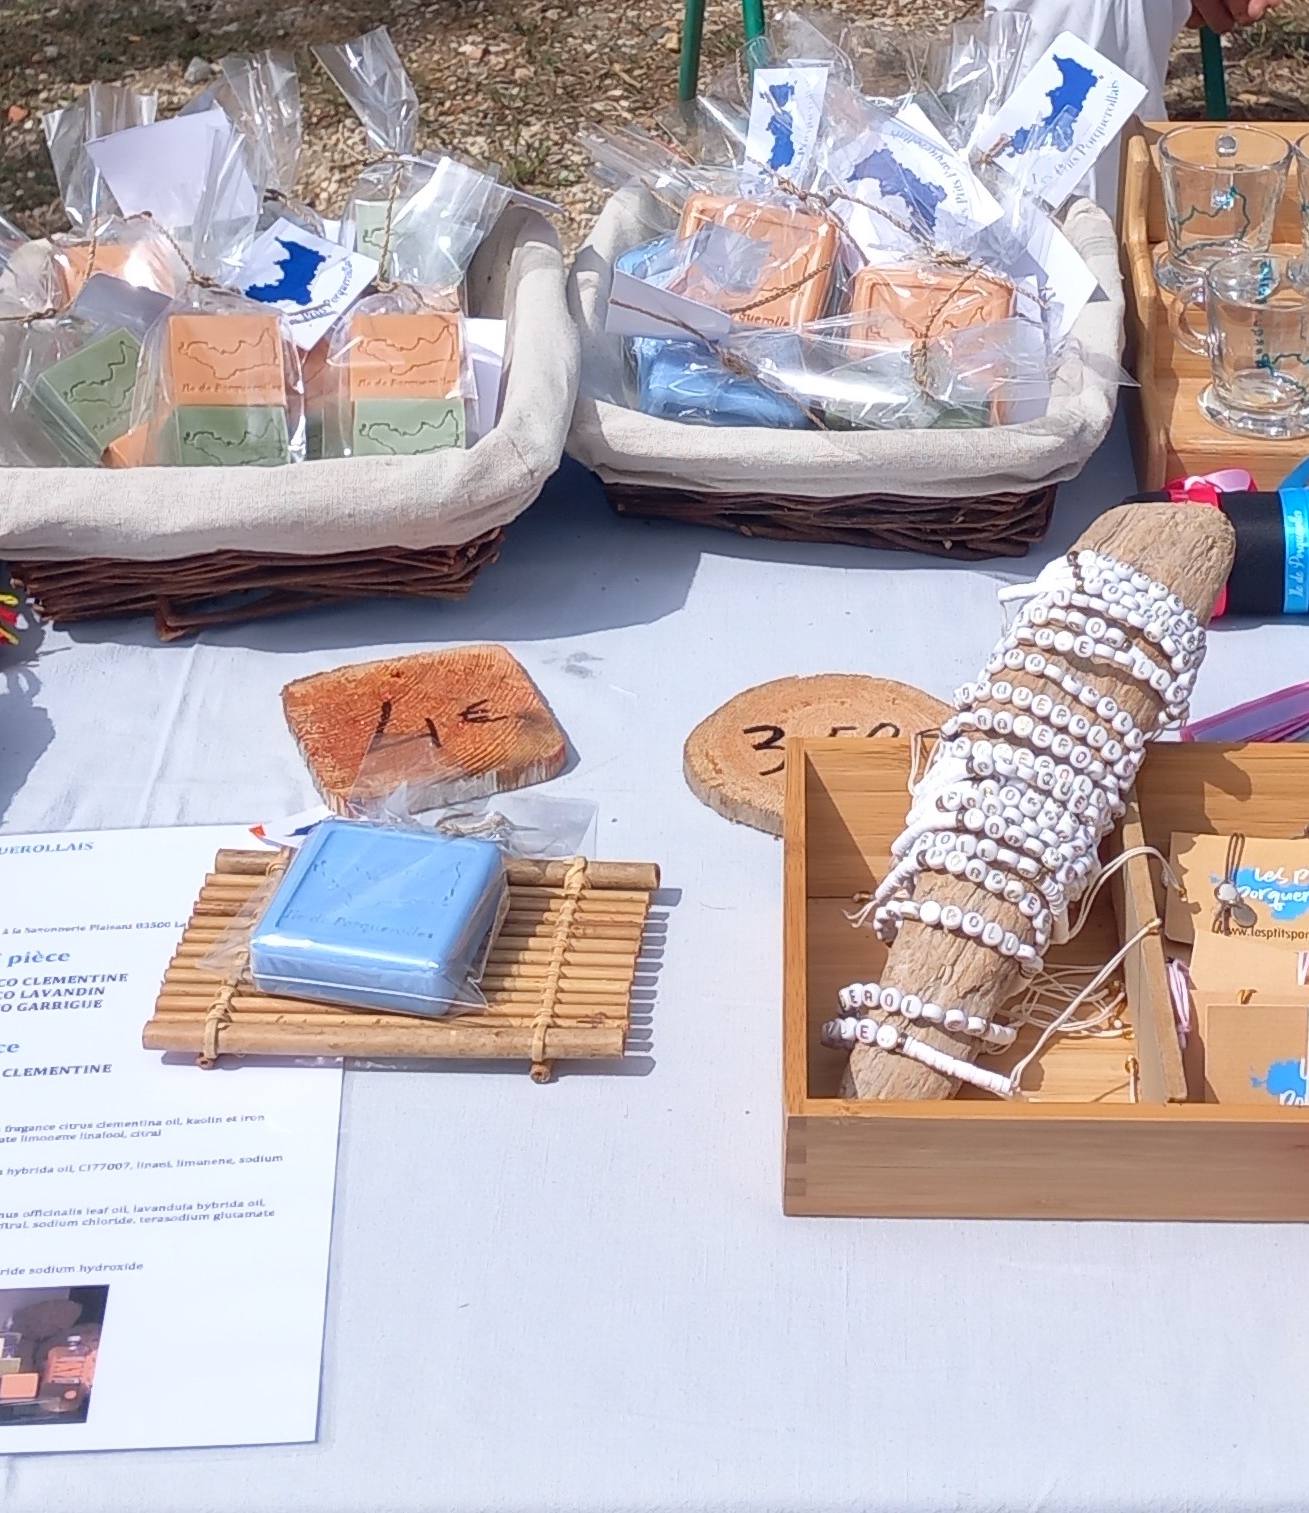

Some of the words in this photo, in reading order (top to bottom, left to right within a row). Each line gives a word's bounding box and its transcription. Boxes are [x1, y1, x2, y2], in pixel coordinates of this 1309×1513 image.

[6, 951, 71, 968] pièce
[22, 973, 130, 986] CLEMENTINE
[20, 986, 106, 999] LAVANDIN
[16, 999, 104, 1013] GARRIGUE
[1, 1064, 113, 1078] CLEMENTINE
[241, 1113, 265, 1122] iron
[238, 1153, 284, 1164] sodium
[32, 1217, 79, 1228] sodium
[28, 1263, 76, 1275] sodium
[79, 1261, 144, 1274] hydroxide
